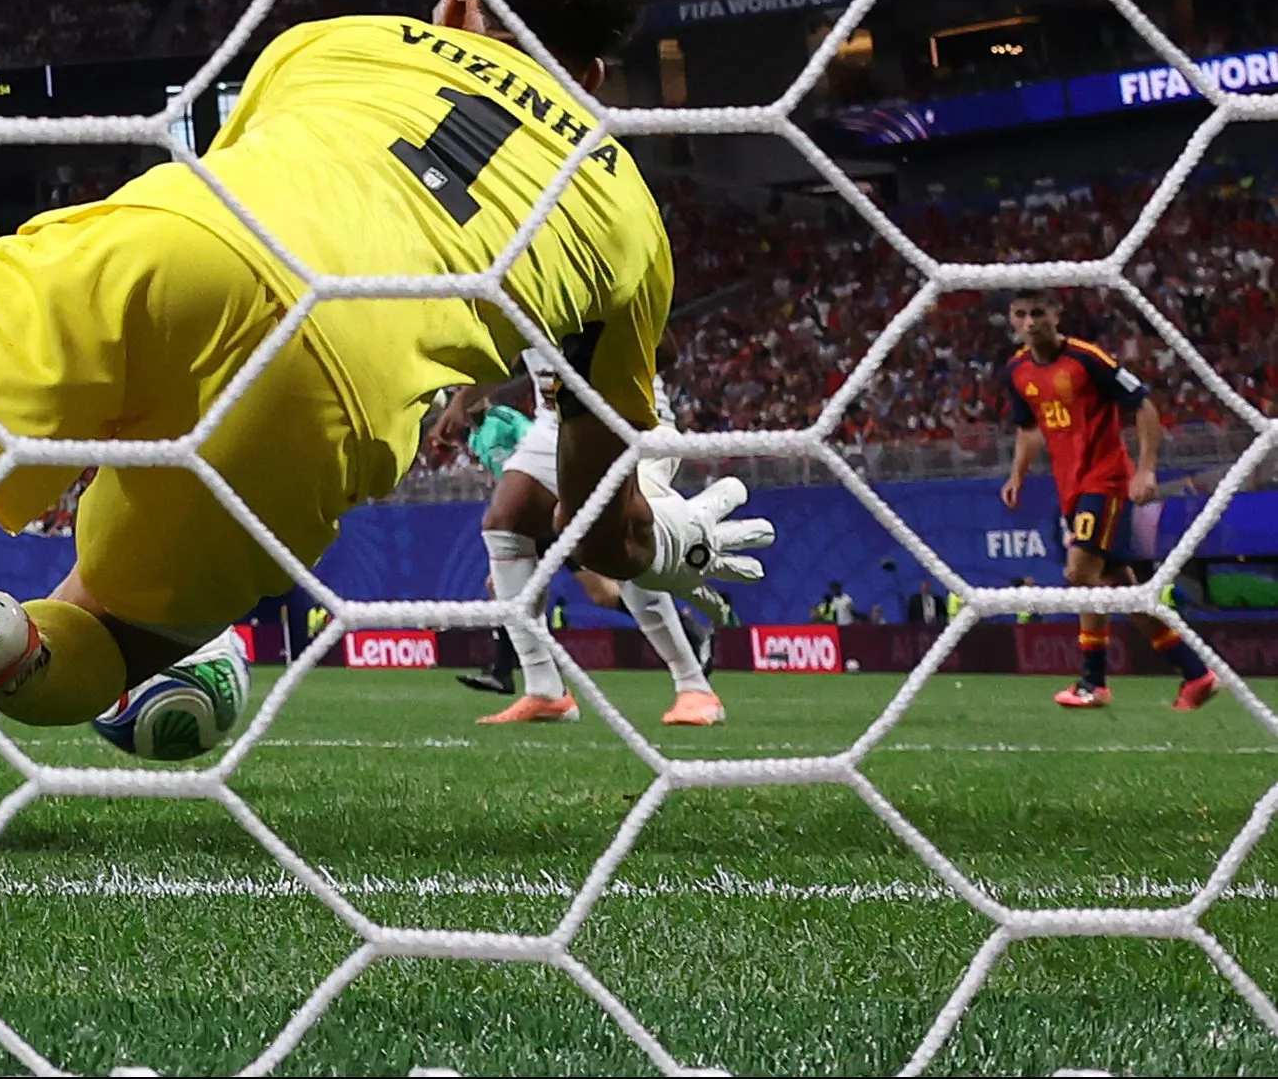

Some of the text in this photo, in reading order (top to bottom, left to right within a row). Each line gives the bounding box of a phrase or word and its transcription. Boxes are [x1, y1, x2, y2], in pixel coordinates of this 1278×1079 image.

[400, 23, 620, 178] VOZINHA
[1118, 66, 1192, 105] FIFA
[388, 86, 524, 228] 1
[986, 529, 1047, 559] FIFA
[750, 627, 837, 671] Lenovo
